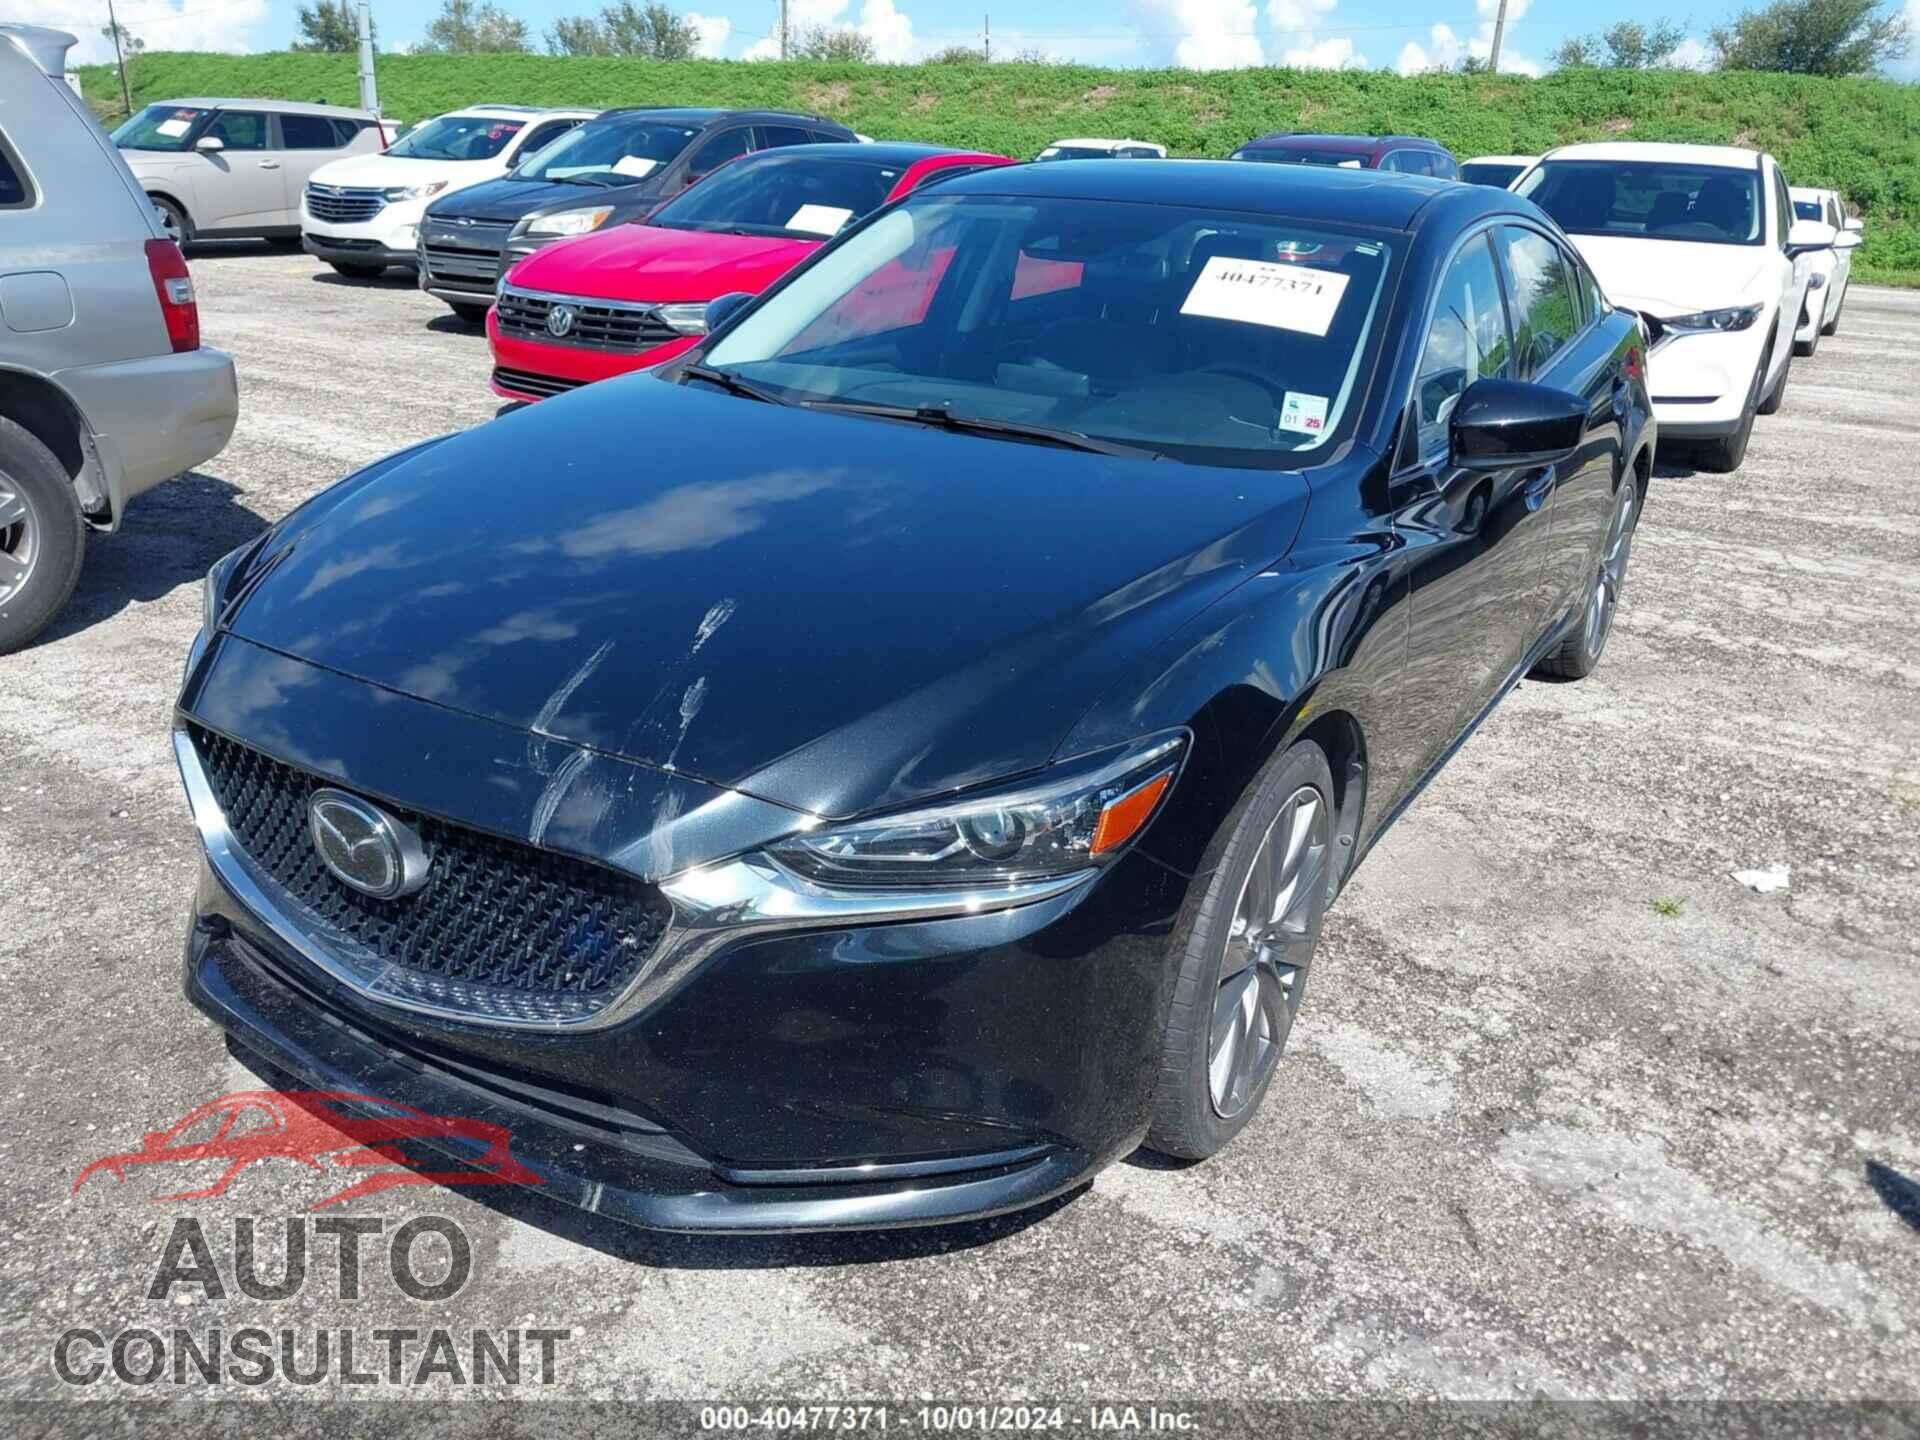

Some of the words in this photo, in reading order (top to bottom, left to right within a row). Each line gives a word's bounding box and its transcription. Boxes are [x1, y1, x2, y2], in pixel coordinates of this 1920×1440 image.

[1216, 271, 1323, 295] 40477371
[1284, 414, 1297, 425] 01
[1305, 417, 1321, 429] 25
